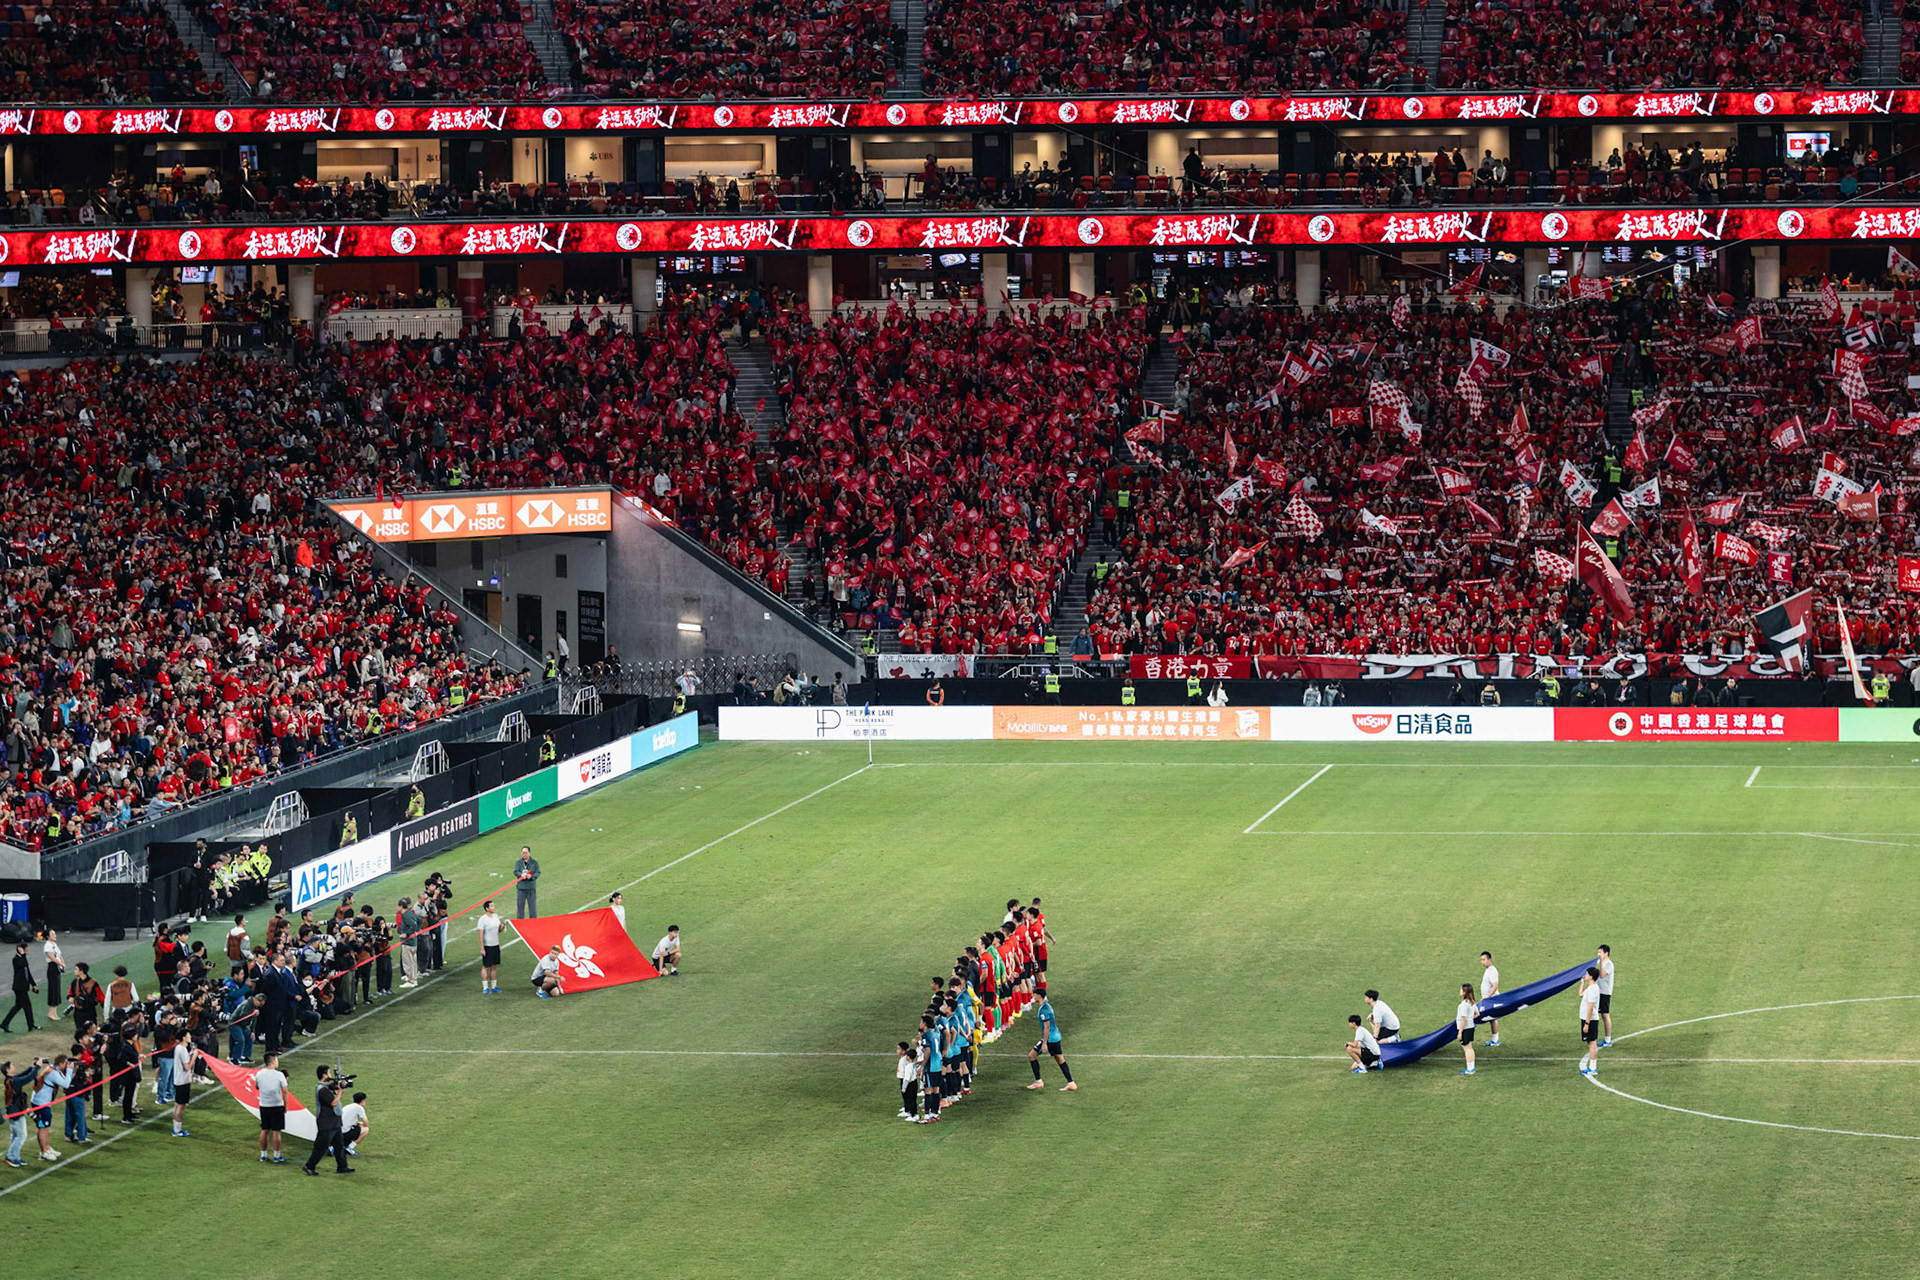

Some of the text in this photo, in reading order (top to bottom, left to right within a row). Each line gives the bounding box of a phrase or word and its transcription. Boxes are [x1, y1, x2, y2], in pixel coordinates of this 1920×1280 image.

[375, 512, 607, 537] HSBC HSBC HSBC
[1721, 547, 1751, 564] KONG
[1145, 657, 1233, 679] 香港力量
[1007, 722, 1048, 733] Mobility
[1356, 715, 1388, 728] NISSIN
[1396, 713, 1473, 735] 日清食品
[1640, 713, 1785, 728] 中國香港足球總會
[404, 811, 473, 851] THUNDER FEATHER
[296, 859, 354, 905] AIRSIM
